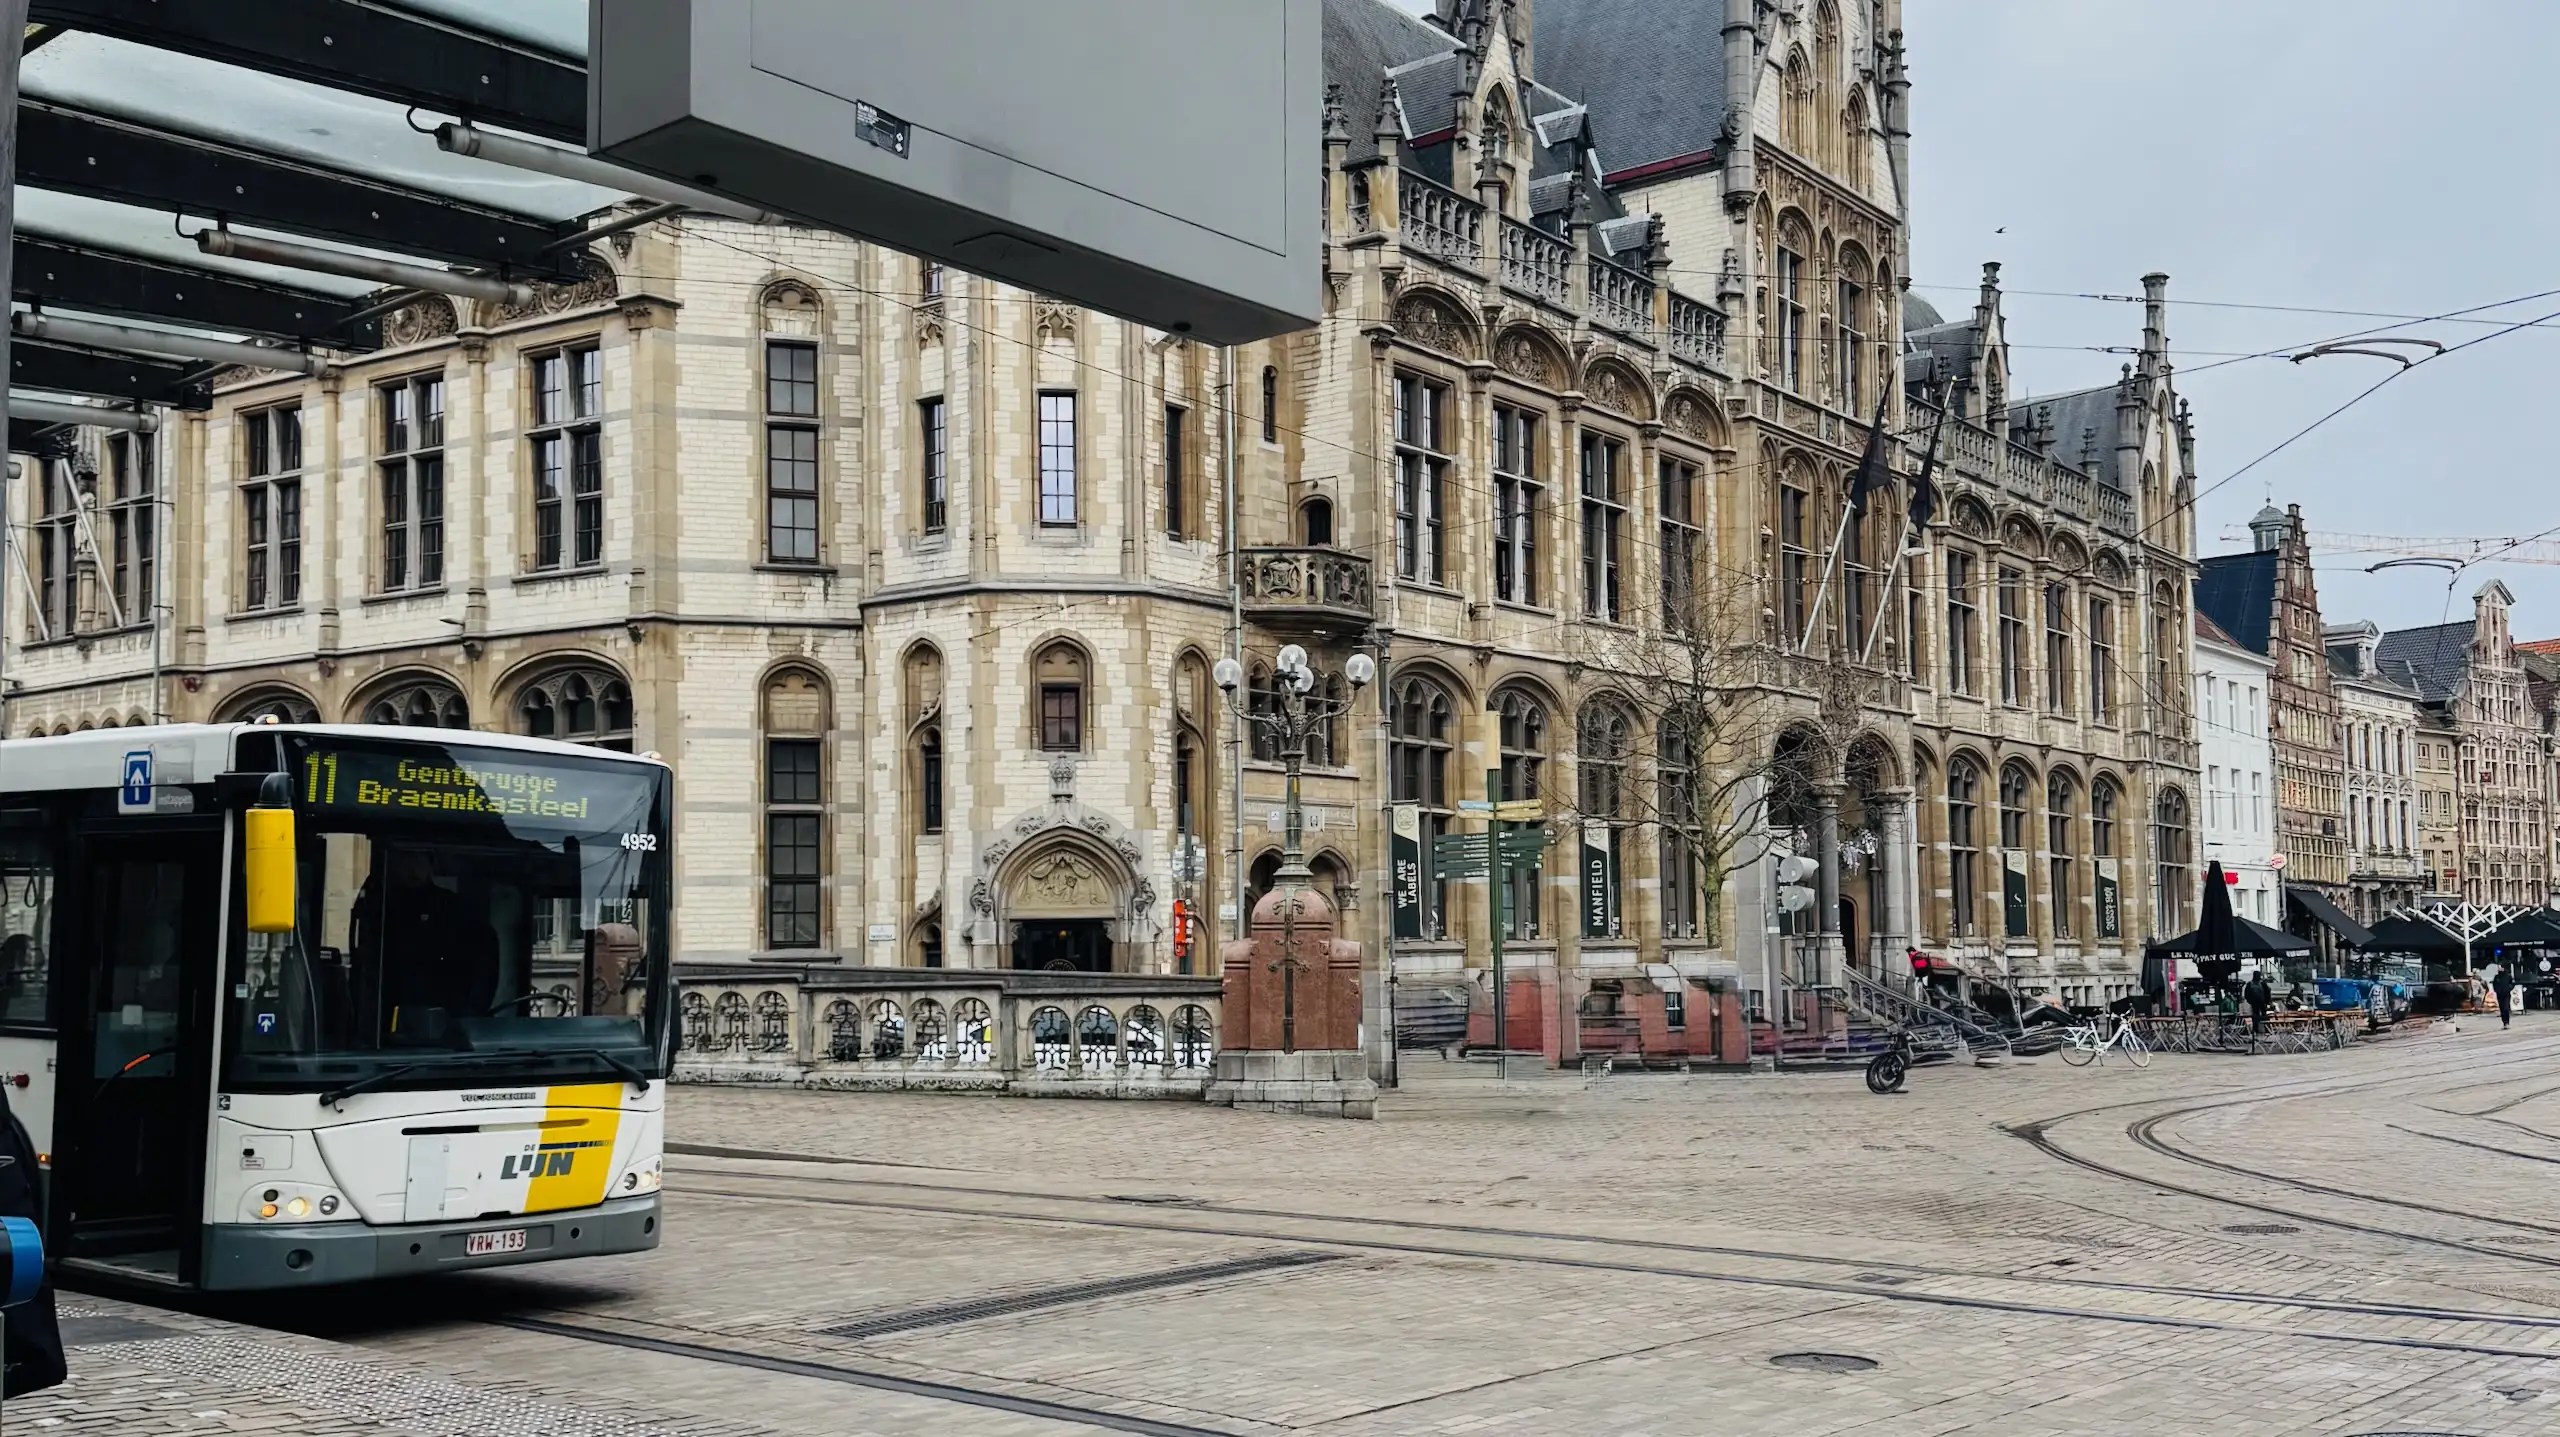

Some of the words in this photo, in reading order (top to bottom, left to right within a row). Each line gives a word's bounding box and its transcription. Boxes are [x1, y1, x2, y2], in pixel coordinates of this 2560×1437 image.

[305, 752, 337, 804] 11
[398, 759, 558, 793] Gentbrugge
[358, 779, 588, 818] Braemkasteel
[620, 832, 657, 851] 4952
[1397, 859, 1407, 881] ARE
[1407, 862, 1418, 904] LABELS
[1397, 890, 1408, 909] WE
[1591, 859, 1604, 927] MANFIELD
[524, 1144, 536, 1152] DE
[500, 1151, 575, 1180] LIJN
[467, 1231, 525, 1251] VRW-193
